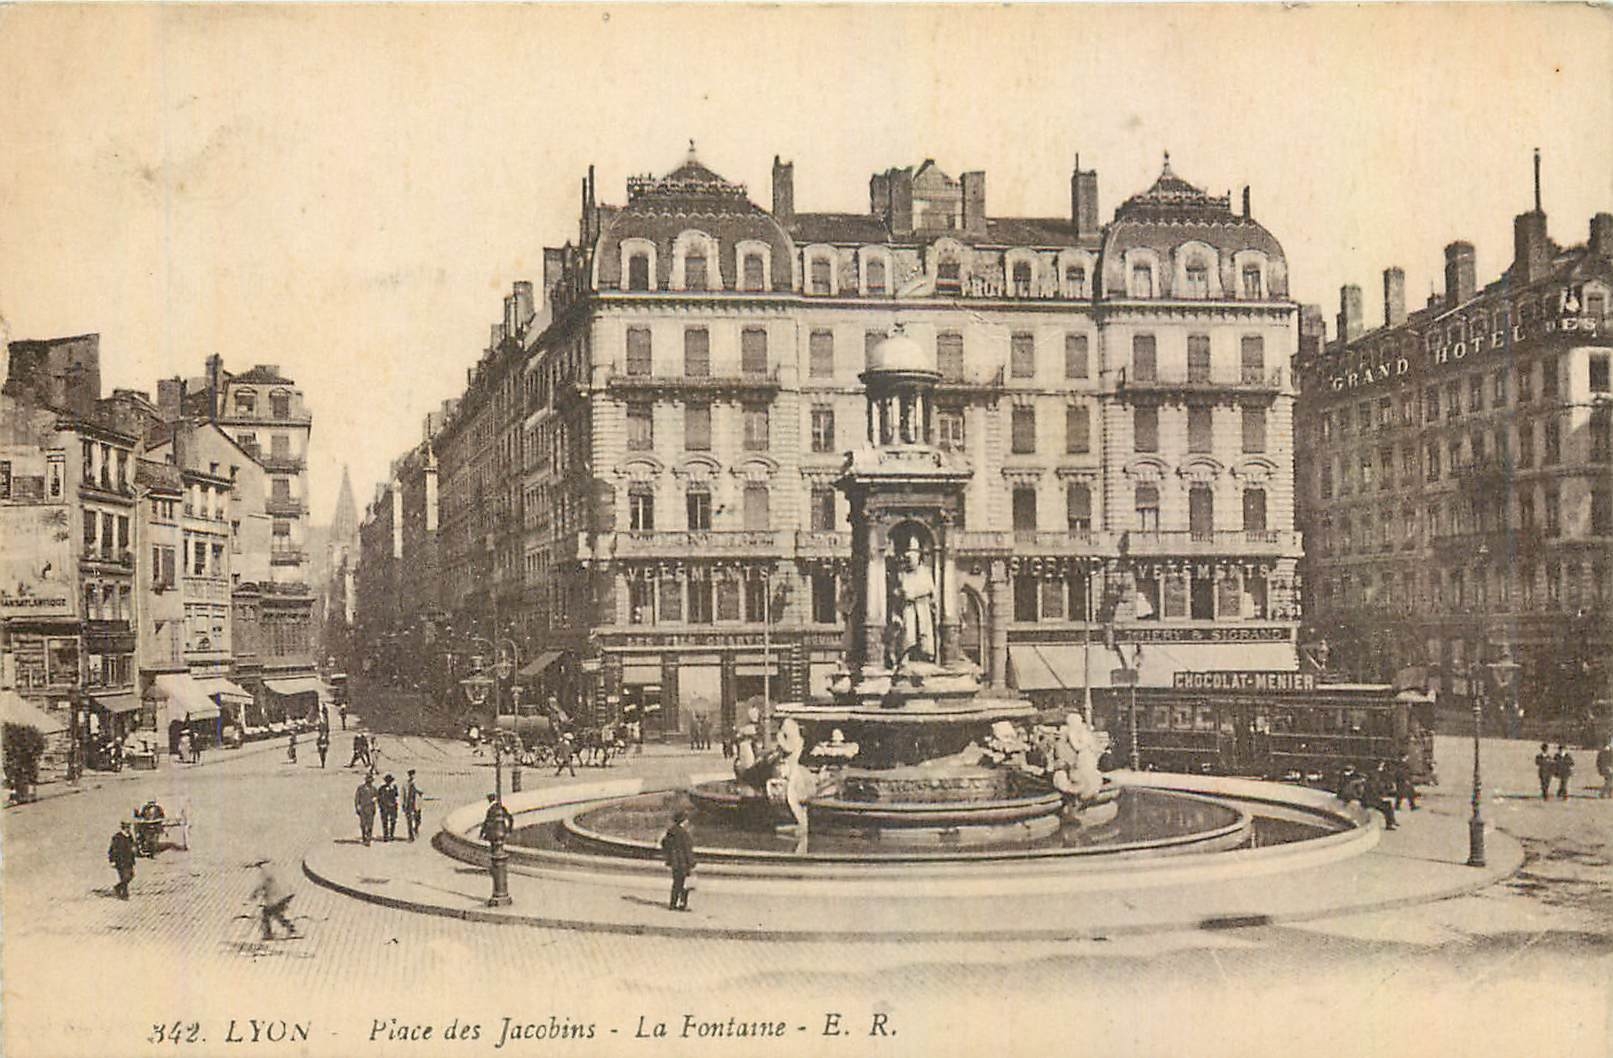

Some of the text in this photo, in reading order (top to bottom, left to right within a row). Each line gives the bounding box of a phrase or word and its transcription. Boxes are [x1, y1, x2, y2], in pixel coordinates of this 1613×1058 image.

[1331, 359, 1409, 391] GRAND
[1435, 325, 1525, 365] HOTEL
[1211, 629, 1283, 640] SIGRAND
[1174, 673, 1314, 690] CHOCOLAT-MENIER
